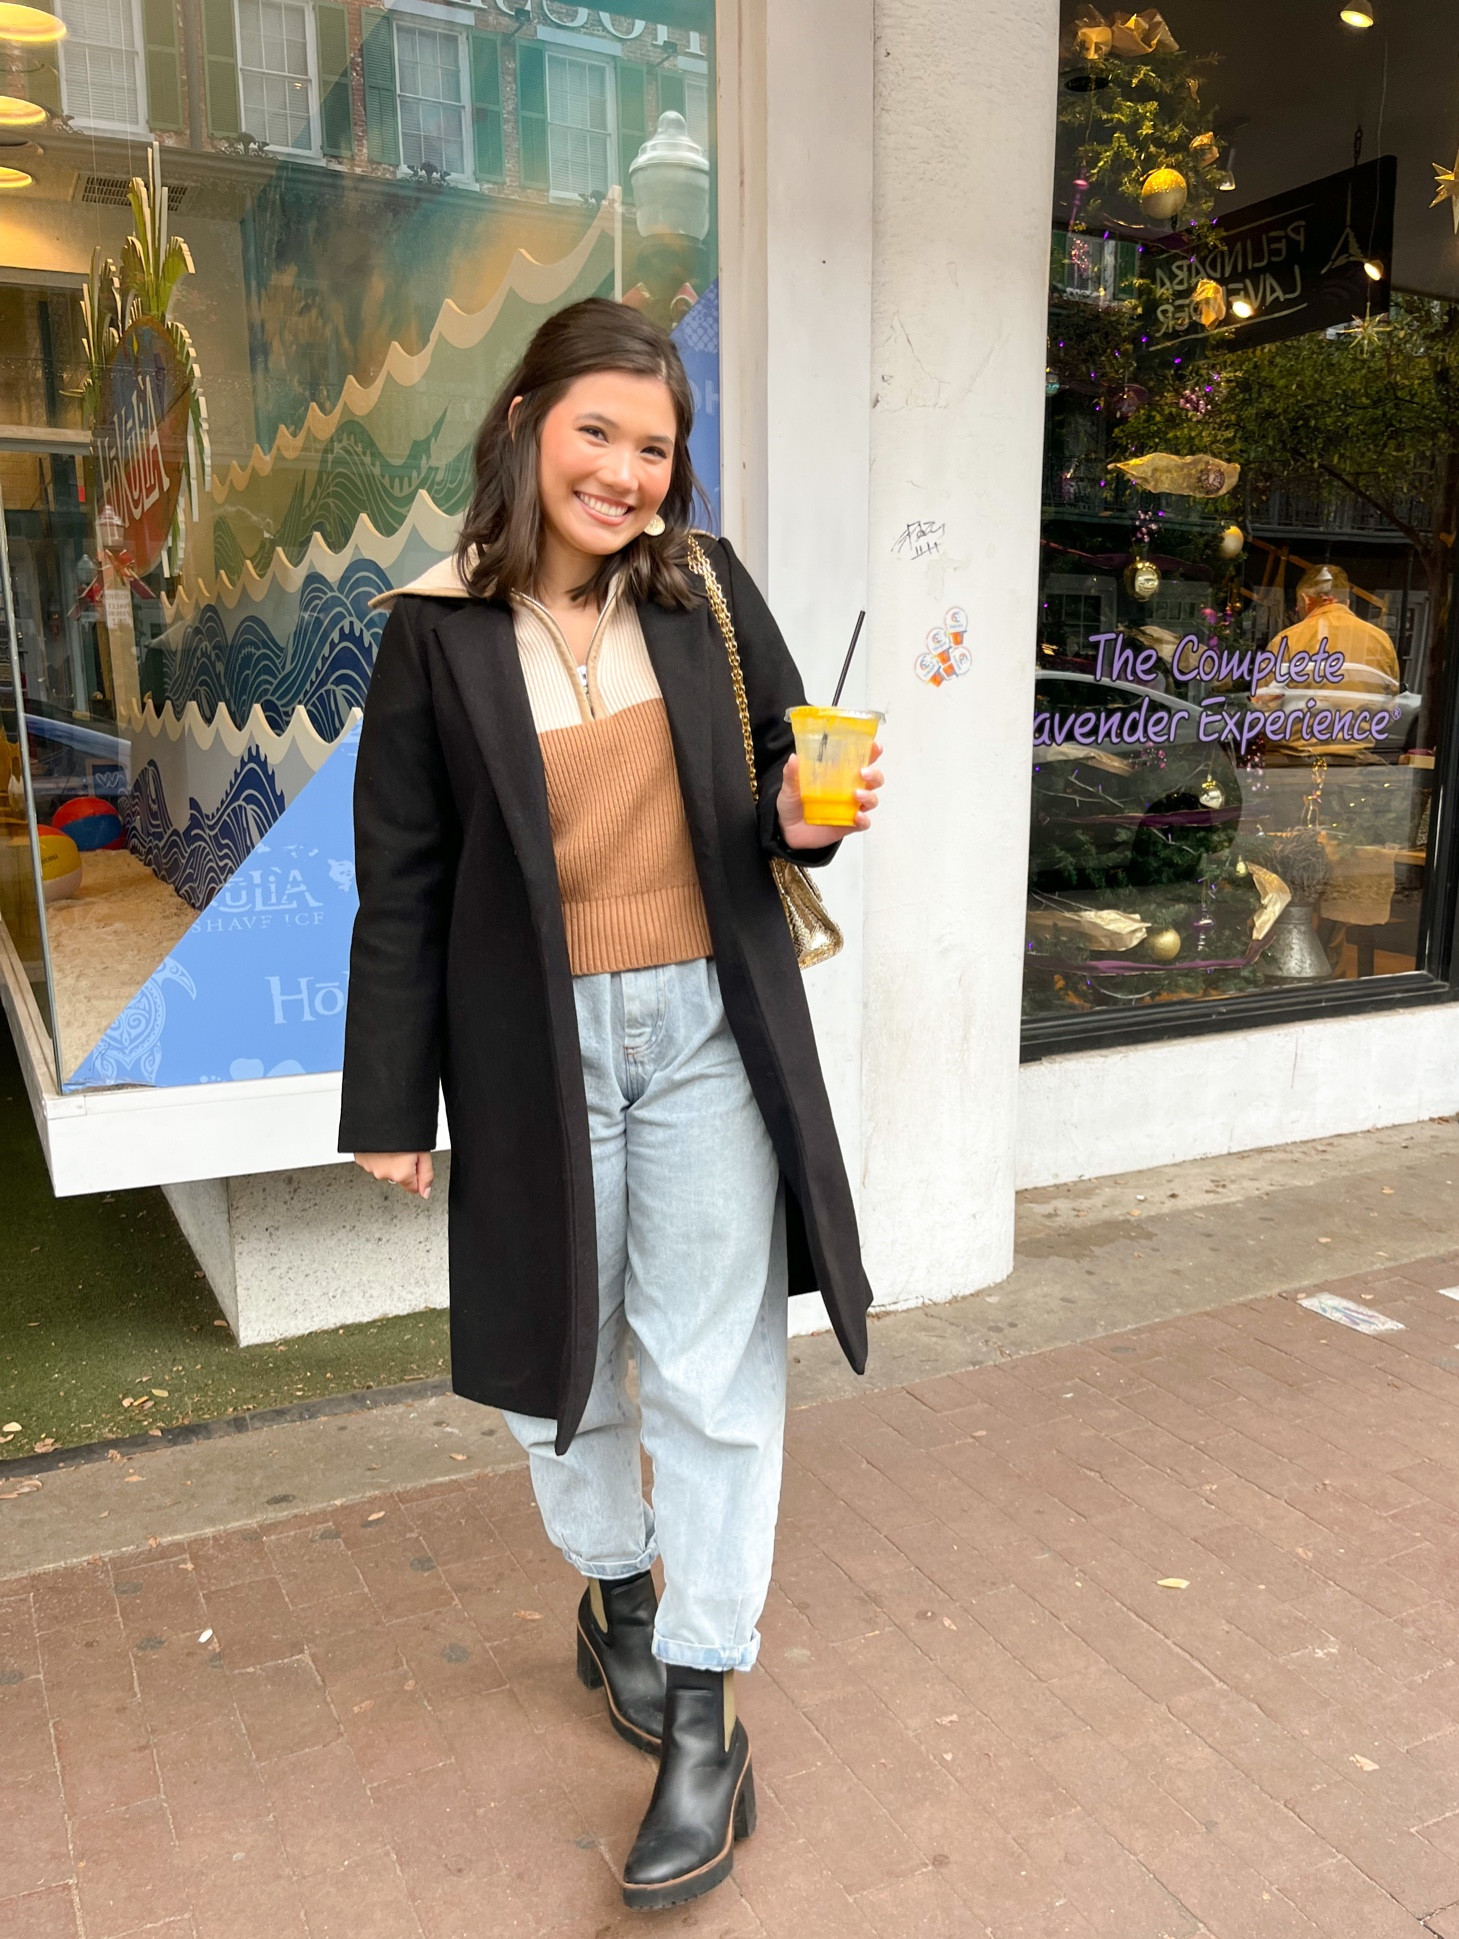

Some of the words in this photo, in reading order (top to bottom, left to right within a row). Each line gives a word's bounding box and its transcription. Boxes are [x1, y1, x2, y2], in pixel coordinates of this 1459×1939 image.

[1088, 632, 1158, 682] The
[1172, 634, 1345, 697] Complete
[1033, 695, 1190, 747] avender
[191, 914, 273, 934] SHAVE
[284, 911, 325, 927] ICE
